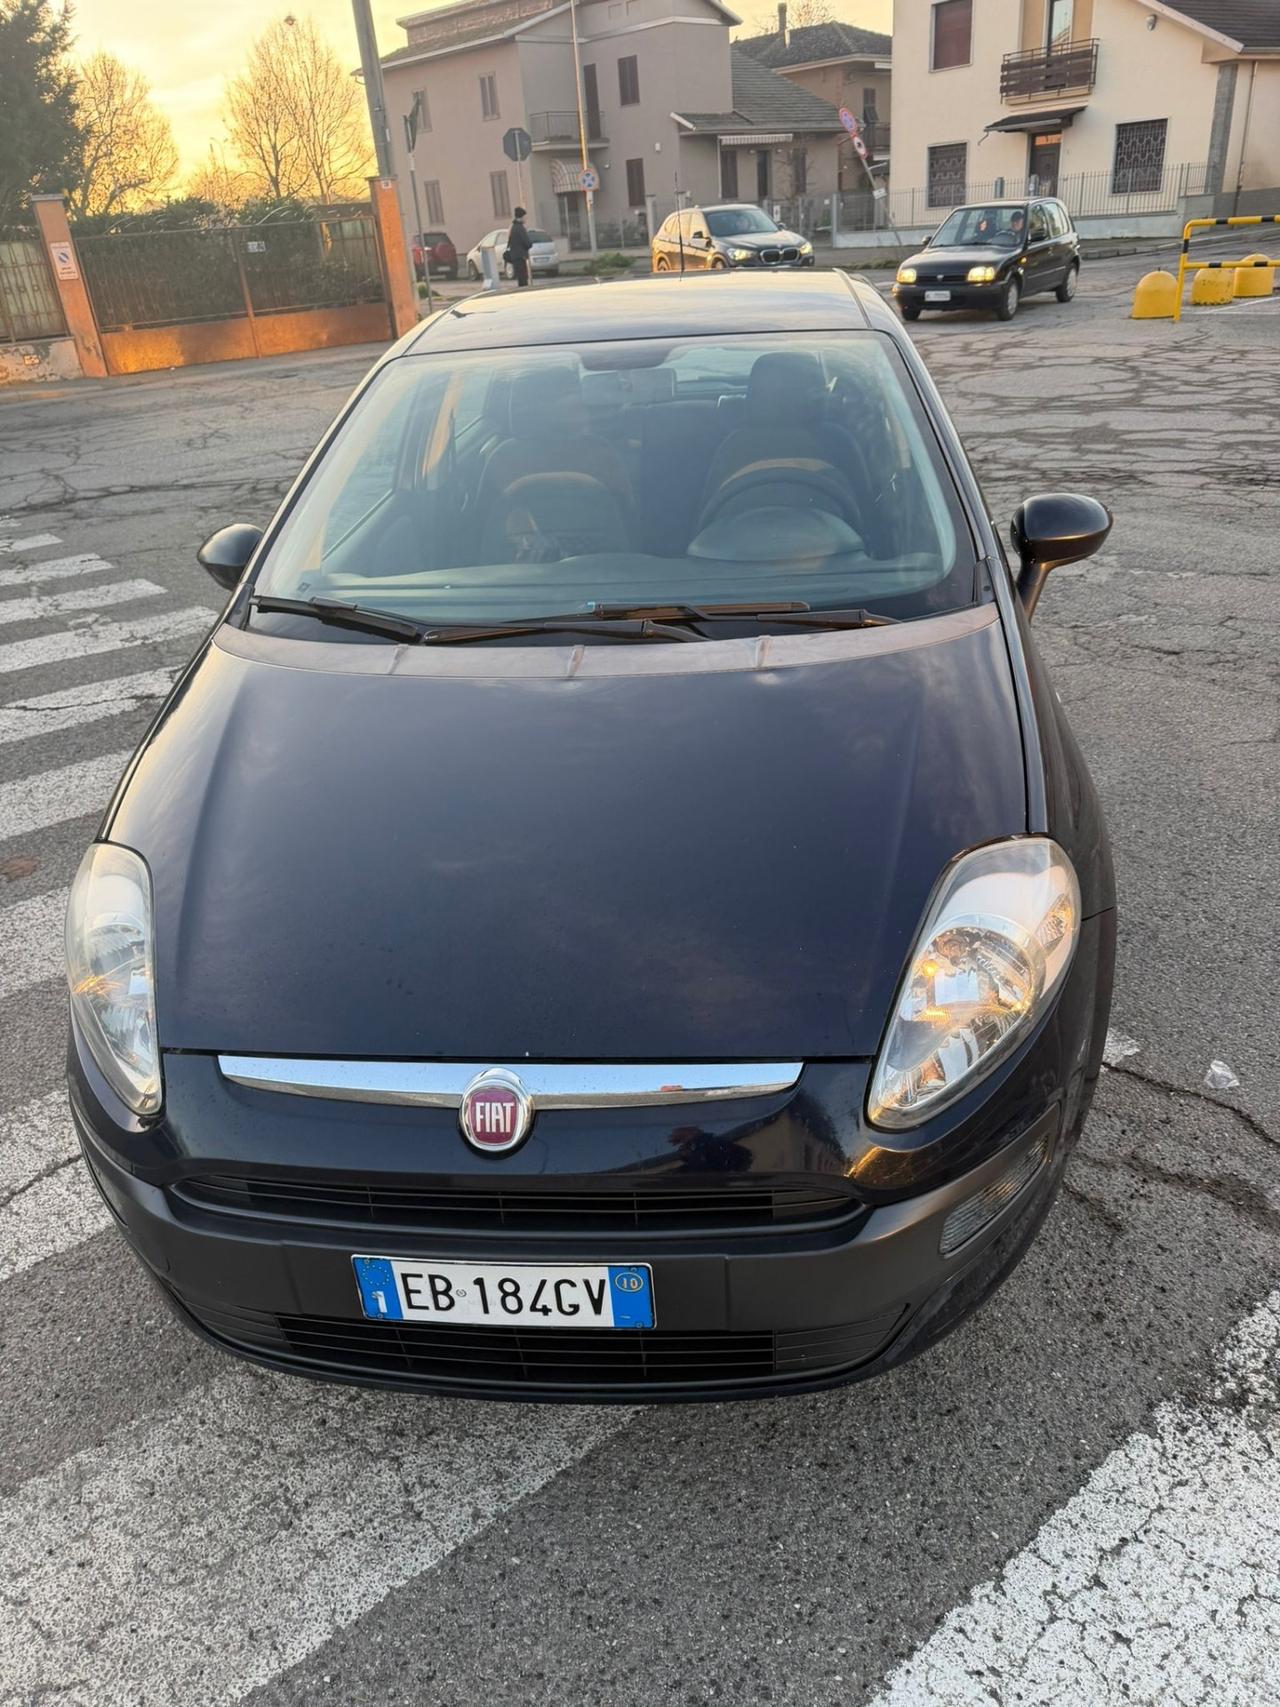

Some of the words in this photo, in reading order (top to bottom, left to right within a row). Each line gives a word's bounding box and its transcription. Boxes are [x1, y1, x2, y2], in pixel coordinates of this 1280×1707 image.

[475, 1102, 514, 1133] FIAT
[400, 1272, 456, 1312] EB
[472, 1277, 606, 1316] 184GV
[621, 1277, 639, 1290] 10
